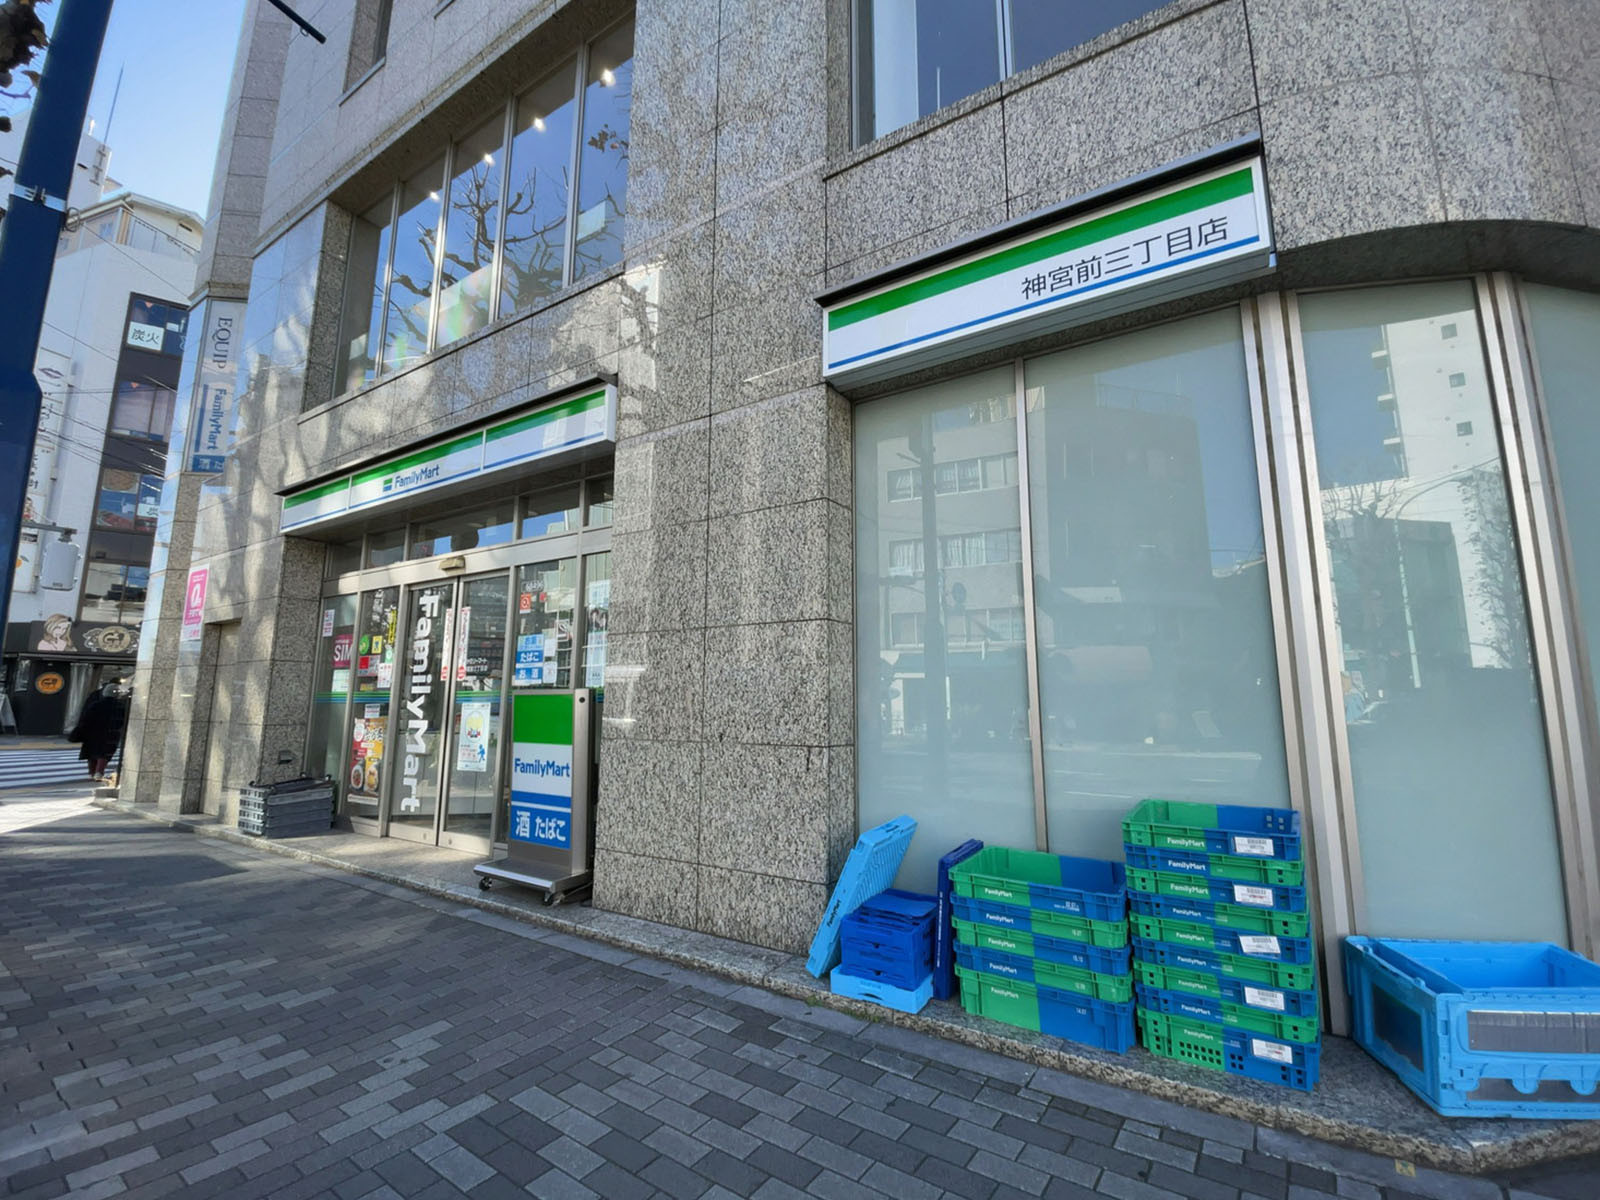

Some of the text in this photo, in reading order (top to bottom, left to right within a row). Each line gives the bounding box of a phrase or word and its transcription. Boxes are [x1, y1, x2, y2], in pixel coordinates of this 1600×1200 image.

[1021, 216, 1228, 300] 神宮前三丁目店
[131, 328, 160, 344] 炭火
[212, 317, 233, 369] EQUIP
[207, 388, 227, 450] FamilyMart
[394, 464, 440, 489] FamilyMart
[400, 593, 440, 813] FamilyMart
[514, 757, 570, 778] FamilyMart
[515, 810, 566, 842] 酒 たばこ
[1167, 837, 1205, 848] FamilyMart
[1168, 860, 1207, 871] FamilyMart
[984, 887, 1012, 898] FamilyMart
[1170, 883, 1209, 895] FamilyMart
[986, 913, 1014, 925] FamilyMart
[1172, 908, 1202, 918] FamilyMart
[988, 937, 1016, 949] FamilyMart
[1176, 932, 1205, 942] FamilyMart
[1177, 956, 1207, 967] FamilyMart
[989, 962, 1018, 975] FamilyMart
[1178, 980, 1208, 991] FamilyMart
[991, 986, 1020, 999] FamilyMart
[1181, 1004, 1211, 1016] FamilyMart
[1184, 1029, 1214, 1040] FamilyMart
